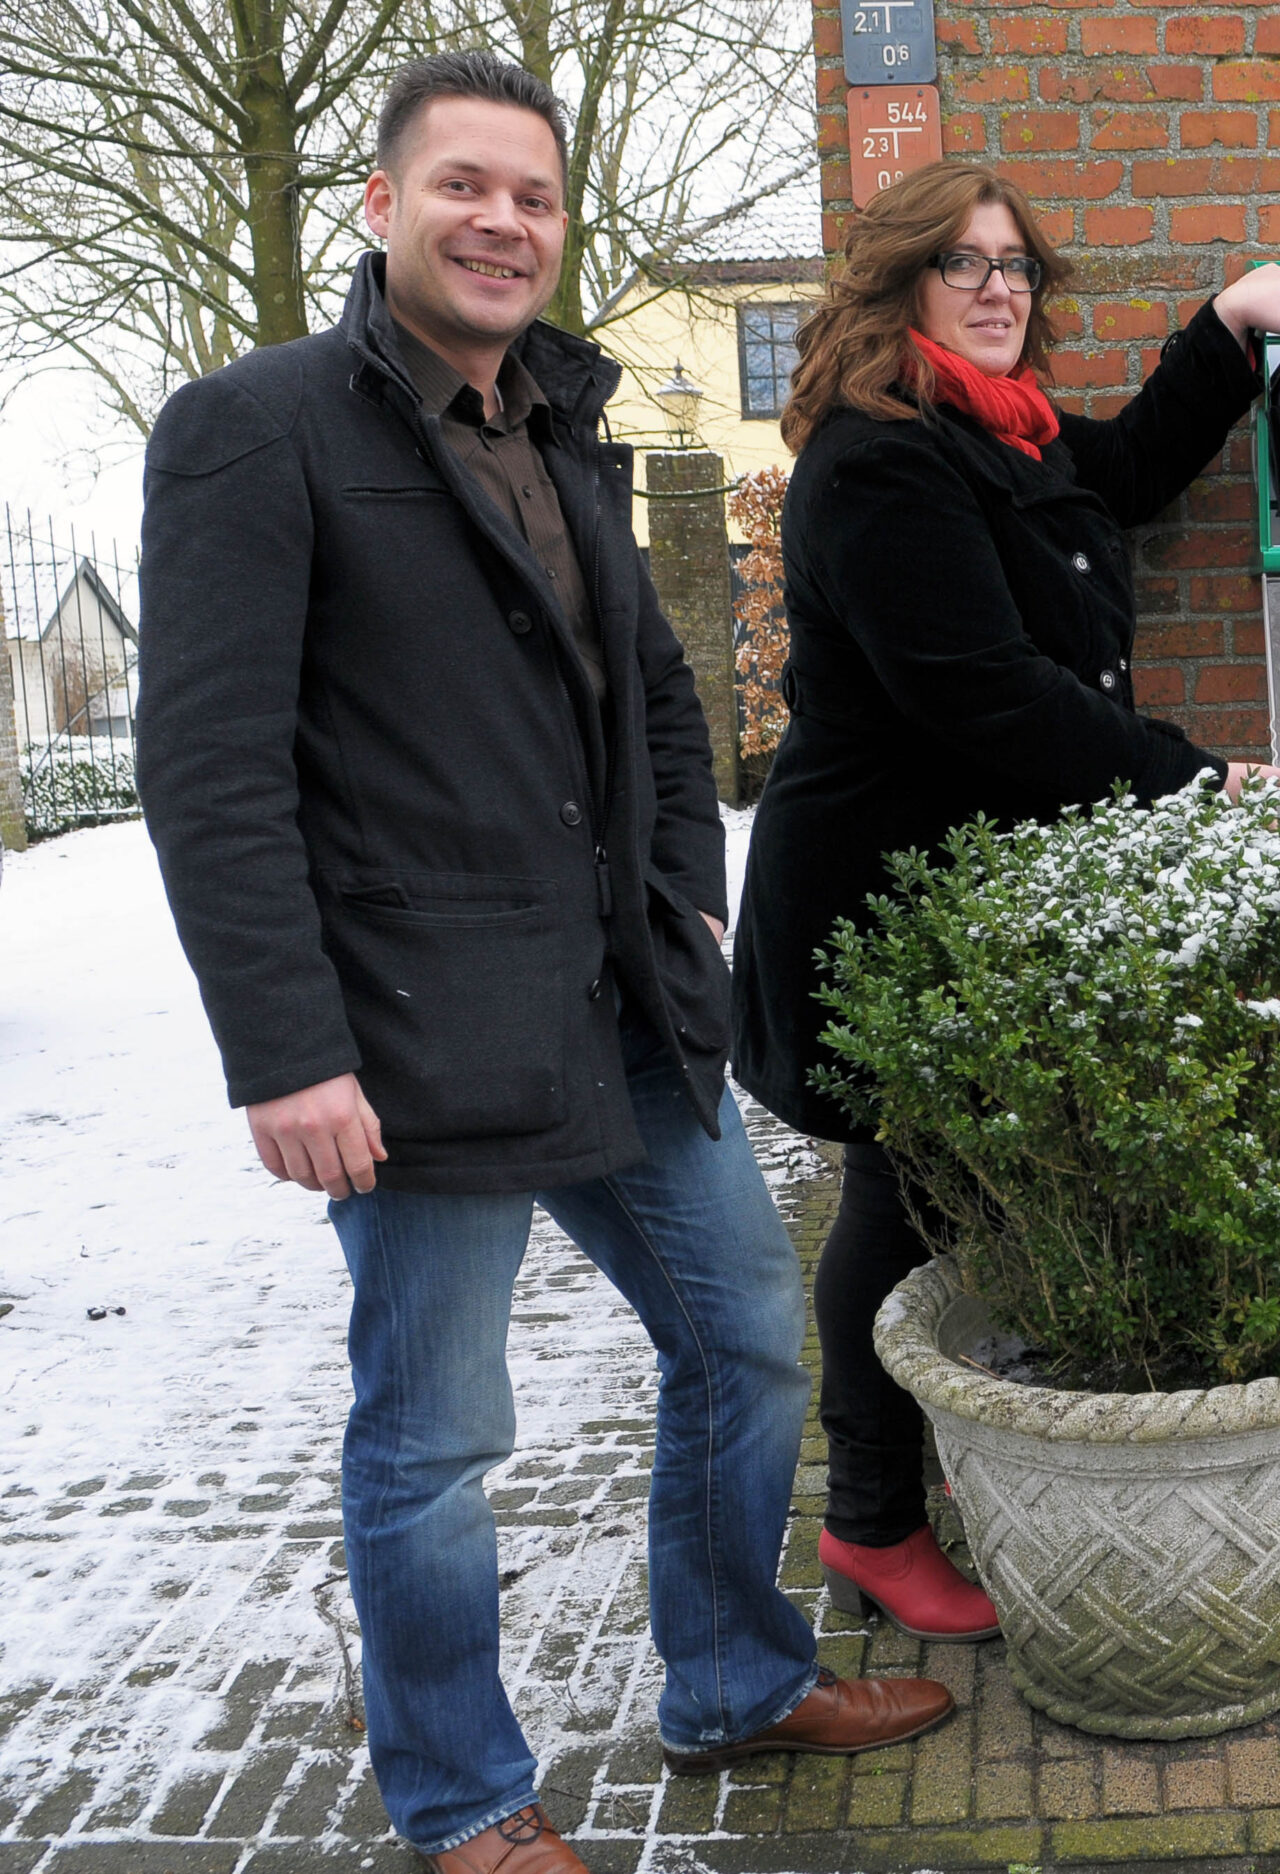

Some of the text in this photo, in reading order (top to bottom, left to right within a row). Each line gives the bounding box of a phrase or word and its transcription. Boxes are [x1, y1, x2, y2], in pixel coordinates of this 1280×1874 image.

[854, 11, 879, 33] 2.1
[882, 45, 909, 66] 0.6
[887, 102, 928, 123] 544
[862, 137, 889, 158] 2.3
